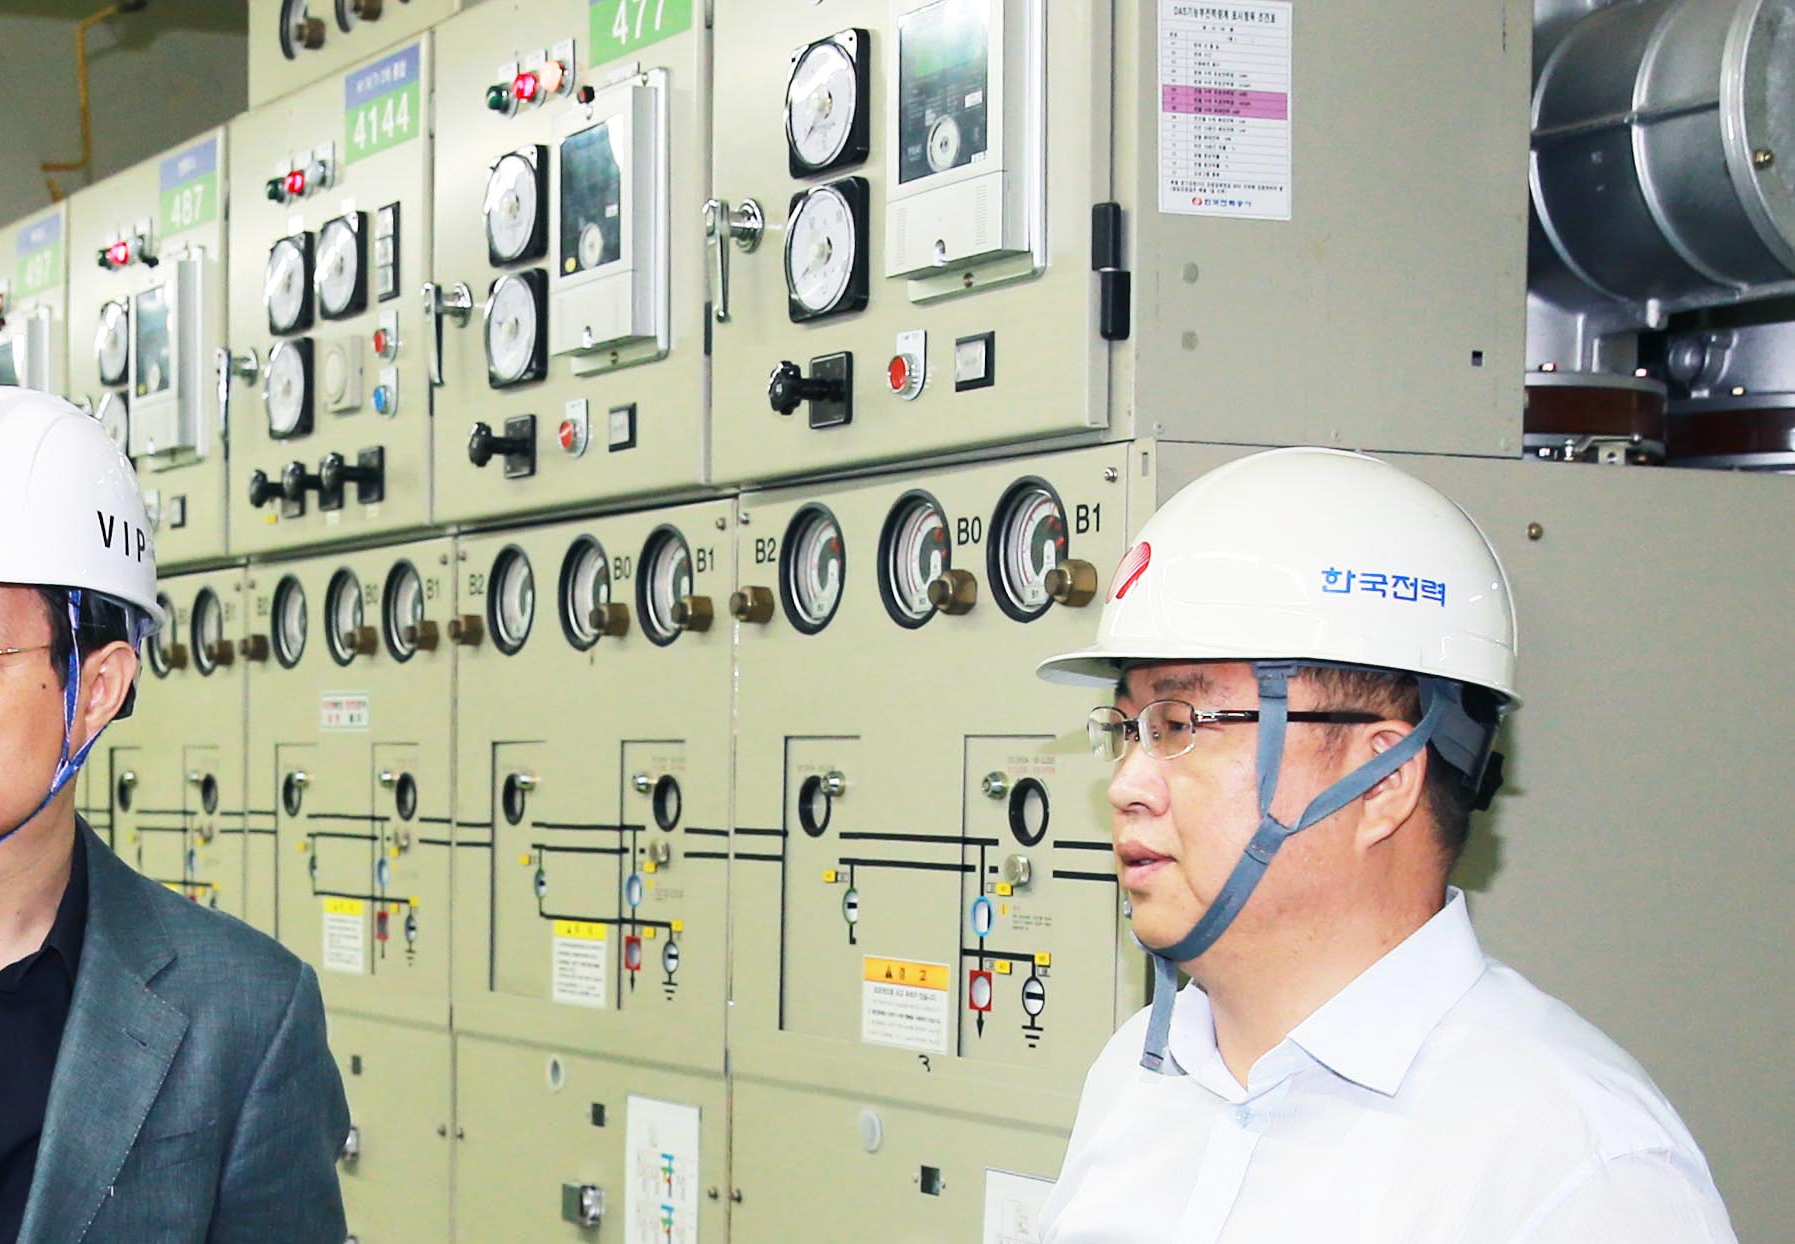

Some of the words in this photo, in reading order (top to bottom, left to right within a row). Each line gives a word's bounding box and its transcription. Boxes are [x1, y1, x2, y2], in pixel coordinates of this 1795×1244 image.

[353, 92, 410, 150] 4144
[171, 184, 205, 228] 487
[1075, 503, 1101, 534] B1
[97, 510, 146, 563] VIP
[755, 538, 777, 564] B2
[696, 548, 715, 573] B1
[426, 578, 440, 600] B1
[469, 574, 484, 595] B2
[1321, 567, 1445, 607] 한국전력
